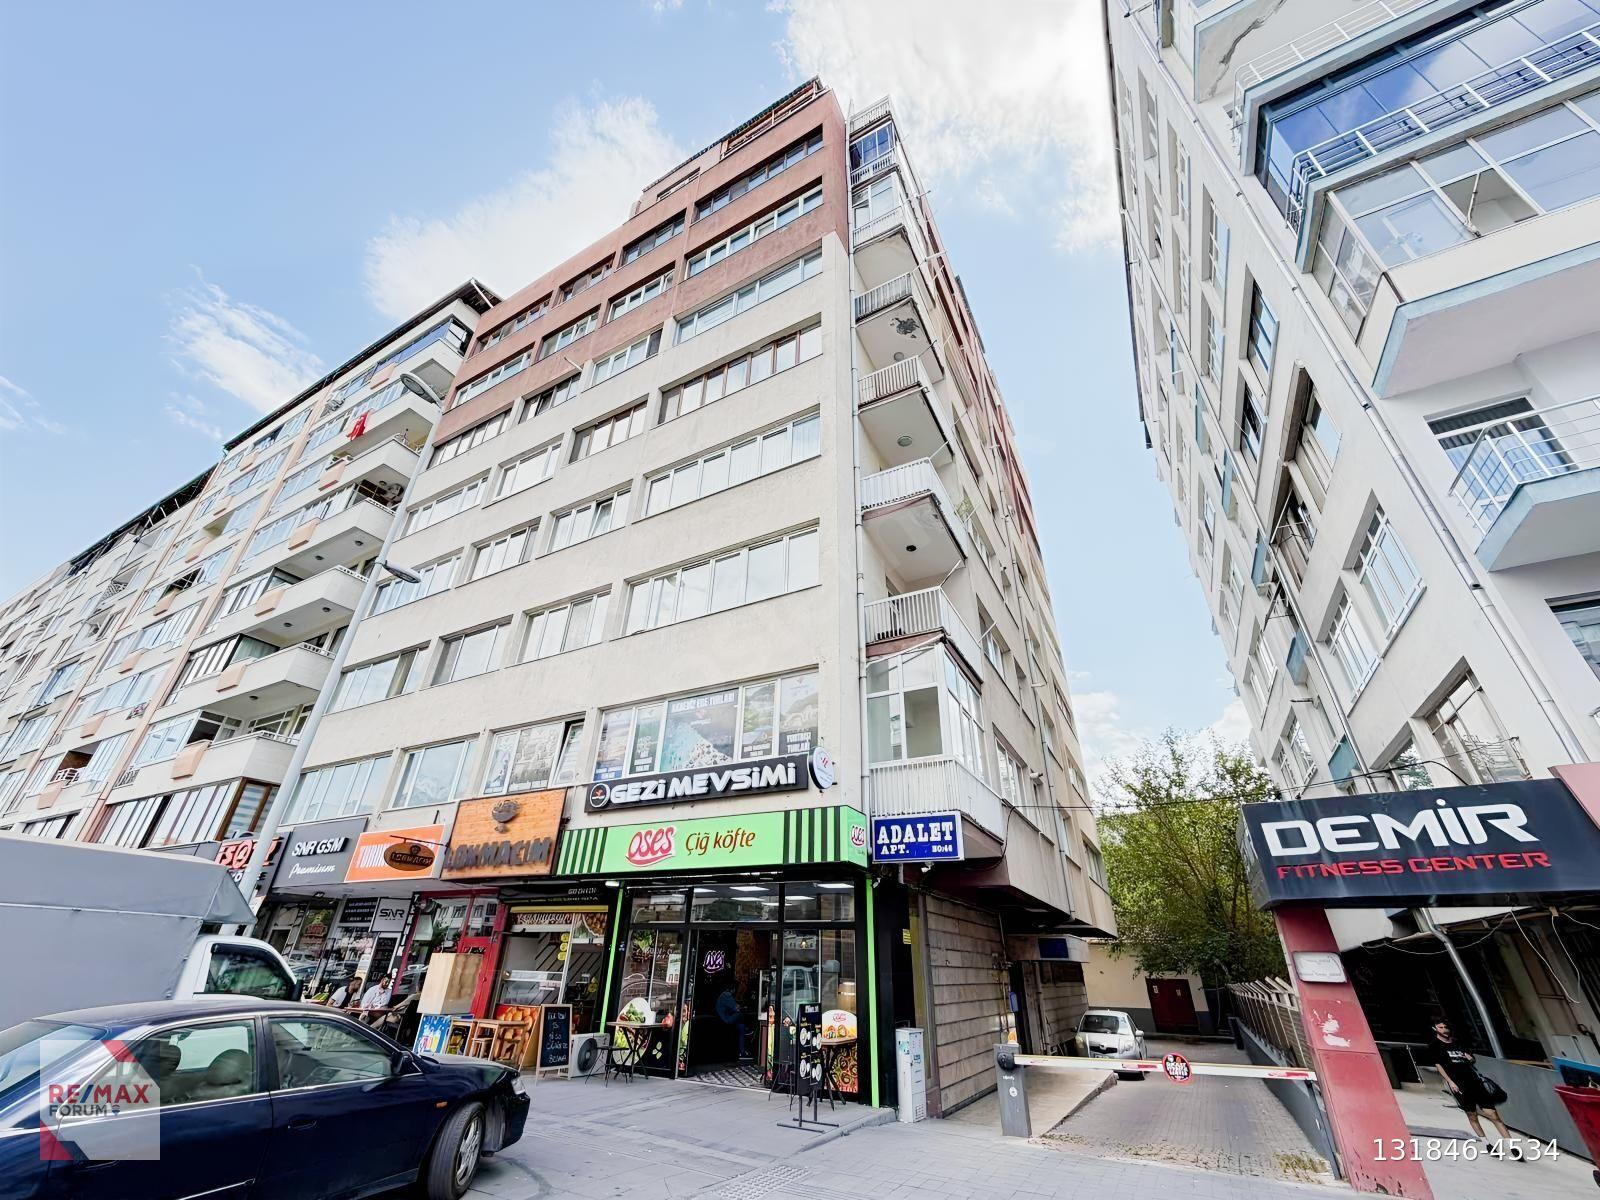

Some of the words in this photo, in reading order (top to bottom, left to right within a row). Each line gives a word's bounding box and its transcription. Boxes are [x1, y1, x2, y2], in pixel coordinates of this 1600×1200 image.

[685, 830, 710, 856] Çiğ
[712, 827, 757, 854] köfte
[876, 821, 953, 845] ADALET
[291, 840, 317, 857] SNR
[316, 836, 347, 854] GSM
[880, 843, 910, 855] APT.
[288, 862, 337, 879] Premium
[1408, 850, 1552, 874] CENTER
